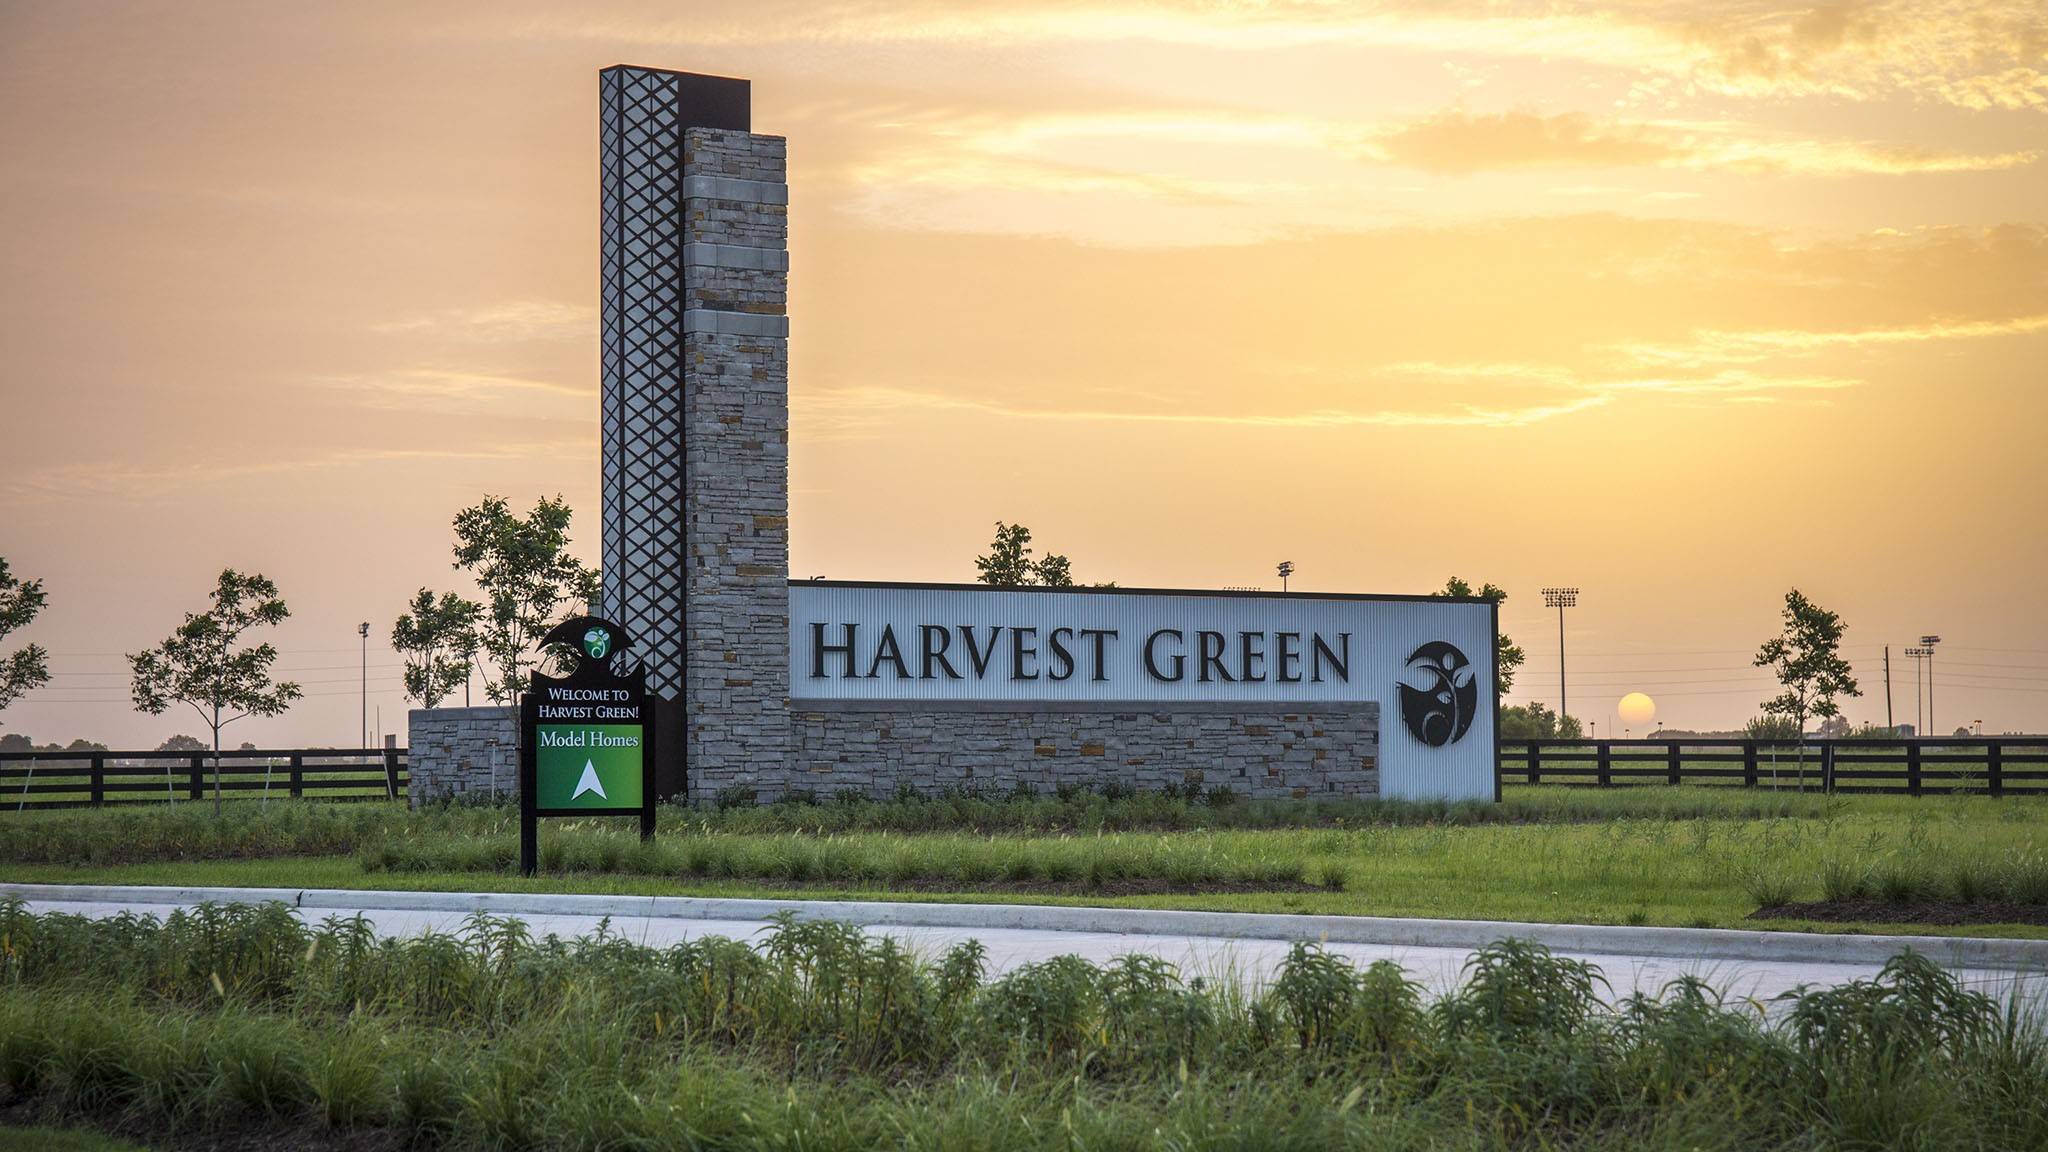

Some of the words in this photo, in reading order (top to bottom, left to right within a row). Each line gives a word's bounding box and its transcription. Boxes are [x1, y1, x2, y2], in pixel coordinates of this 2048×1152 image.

[809, 622, 1119, 681] HARVEST
[1144, 628, 1352, 683] GREEN
[549, 687, 610, 701] WELCOME
[612, 689, 629, 701] TO
[538, 705, 593, 719] HARVEST
[595, 705, 639, 719] GREEN!
[540, 730, 585, 747] Model
[590, 731, 639, 747] Homes
